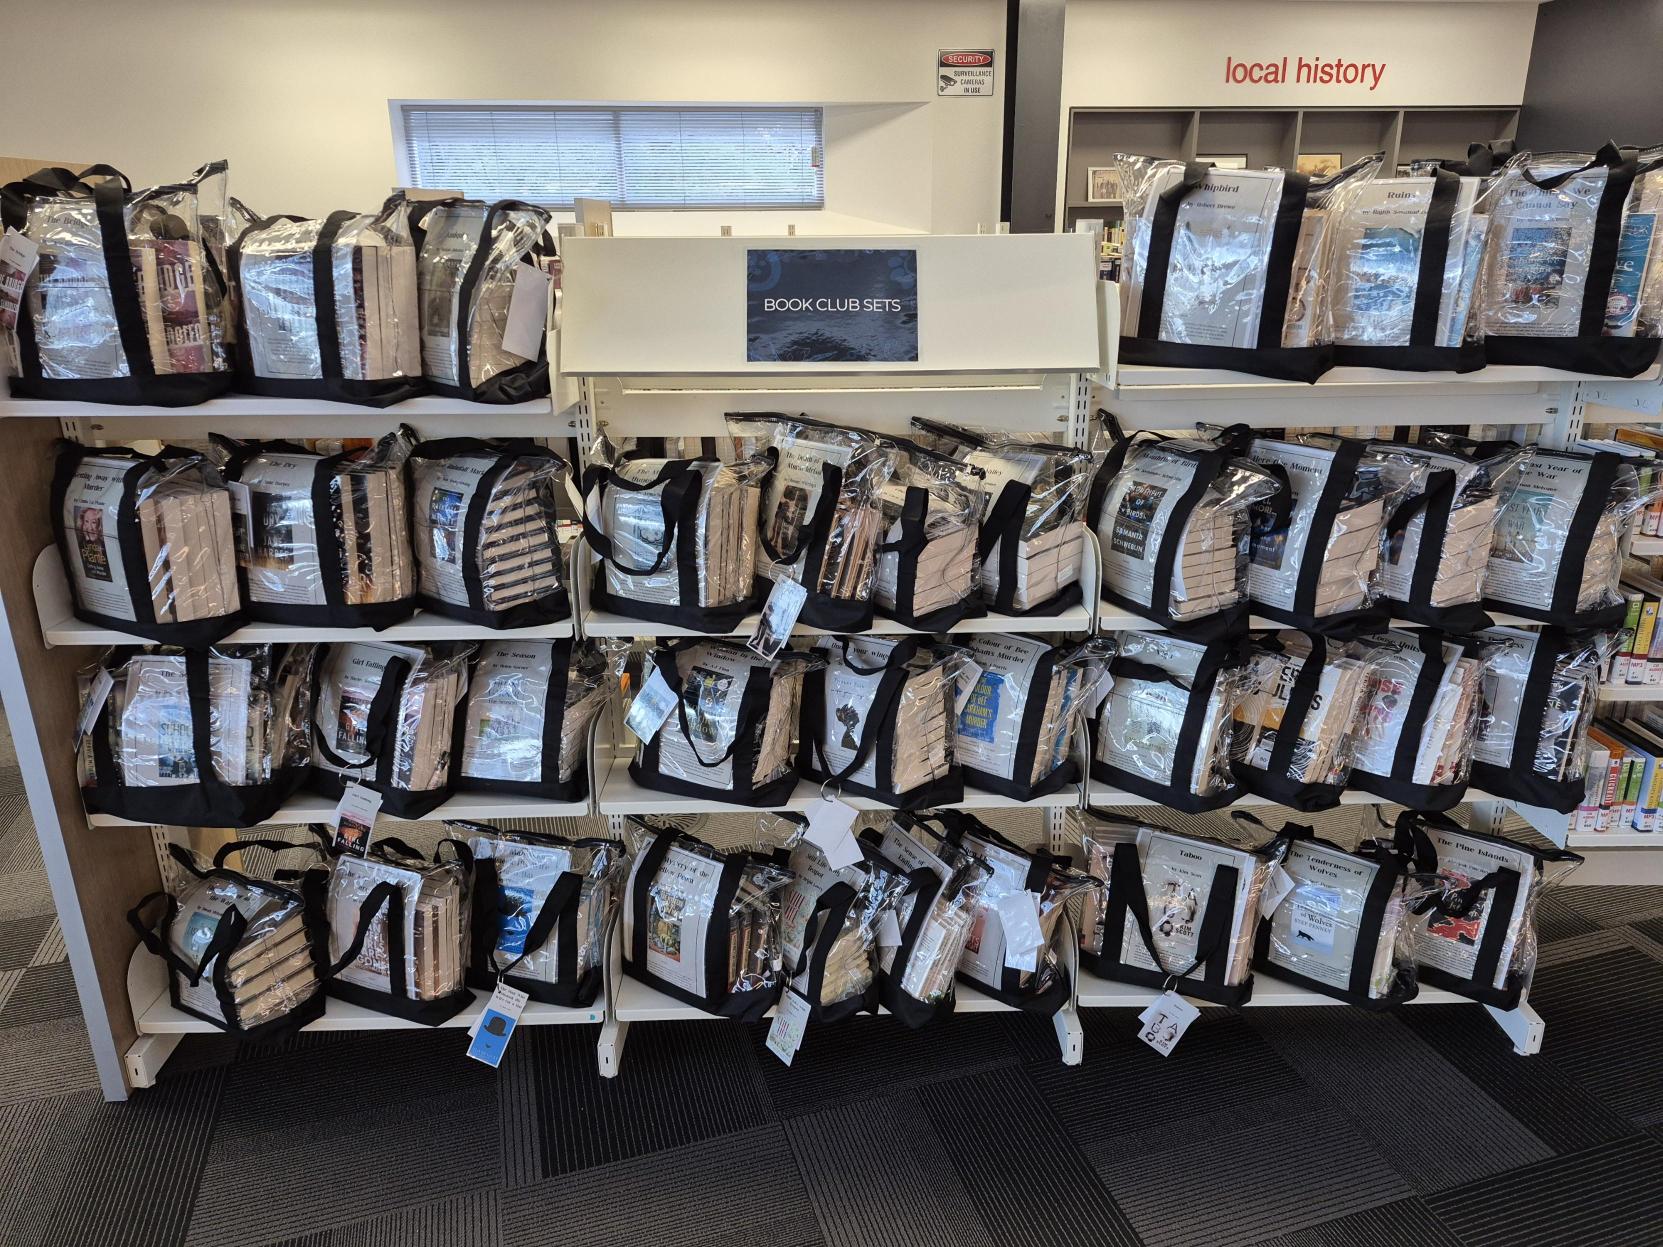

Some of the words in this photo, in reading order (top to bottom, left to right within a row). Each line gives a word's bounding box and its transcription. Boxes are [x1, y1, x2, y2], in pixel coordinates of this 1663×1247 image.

[948, 55, 984, 63] SECURITY
[1225, 57, 1288, 85] local
[1295, 57, 1387, 91] history
[960, 78, 985, 86] CAMERAS
[1387, 191, 1416, 199] Ruins
[764, 298, 813, 312] BOOK
[816, 298, 861, 312] CLUB
[863, 298, 902, 312] SETS
[1252, 455, 1271, 465] Here
[1547, 463, 1569, 472] Year
[1537, 472, 1558, 480] War
[1115, 526, 1144, 541] SAMANTA
[511, 651, 536, 659] Season
[706, 650, 735, 662] Window
[1015, 646, 1029, 655] Bee
[996, 651, 1025, 664] Murder
[338, 729, 366, 744] FALLIN
[904, 846, 918, 861] Sense
[1180, 850, 1203, 861] Taboo
[1437, 837, 1453, 847] The
[1455, 842, 1475, 853] Pine
[1477, 848, 1509, 864] Islands
[1290, 850, 1304, 858] The
[1307, 855, 1351, 873] Tenderness
[1309, 864, 1338, 878] Wolves
[1308, 912, 1333, 928] Wolves
[1175, 928, 1194, 937] SCOTT
